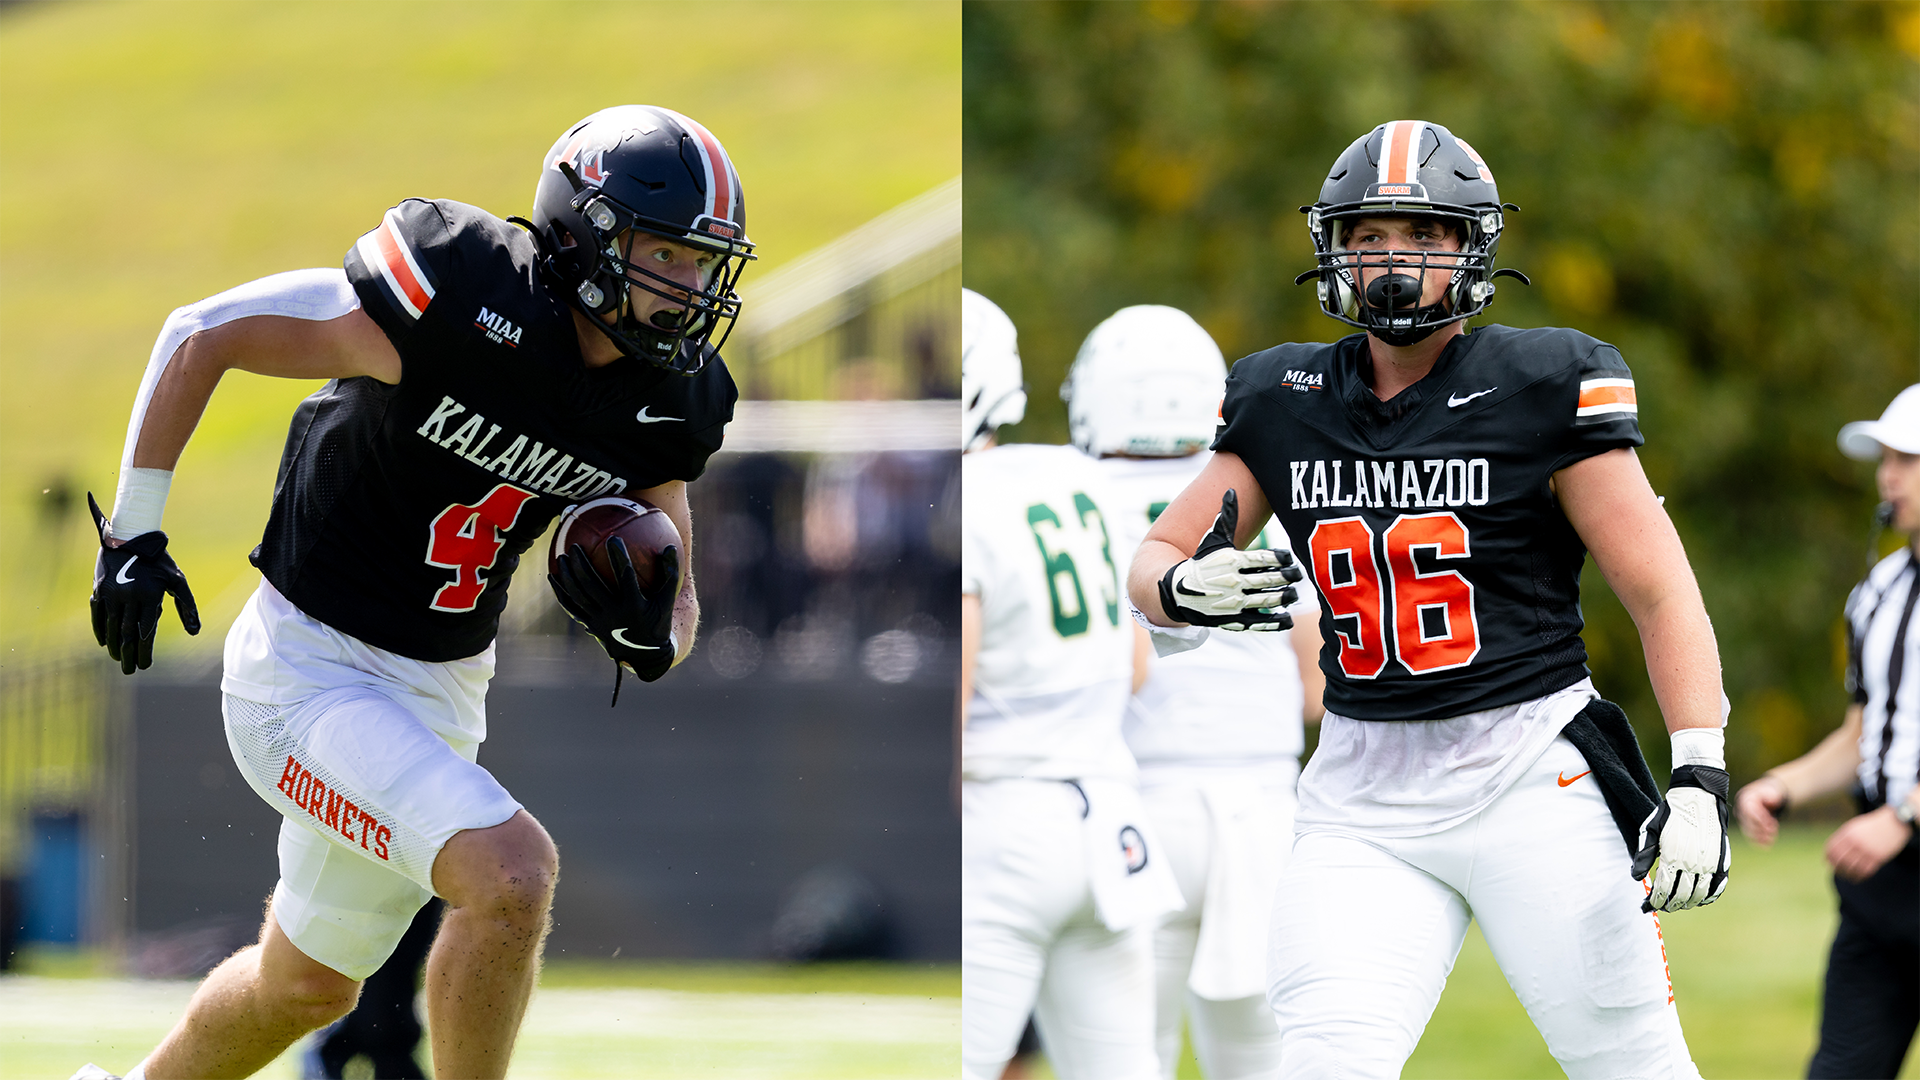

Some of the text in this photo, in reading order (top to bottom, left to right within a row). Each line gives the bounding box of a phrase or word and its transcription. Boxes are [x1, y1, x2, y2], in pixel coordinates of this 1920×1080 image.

[1378, 186, 1412, 195] SWARM
[708, 223, 735, 238] SWARM
[476, 306, 523, 344] MIAA
[485, 330, 504, 344] 1888
[1282, 369, 1323, 386] MIAA
[1290, 458, 1489, 510] KALAMAZOO
[425, 483, 540, 613] 4
[1026, 491, 1120, 640] 63
[1308, 512, 1481, 680] 96
[277, 755, 391, 861] HORNETS
